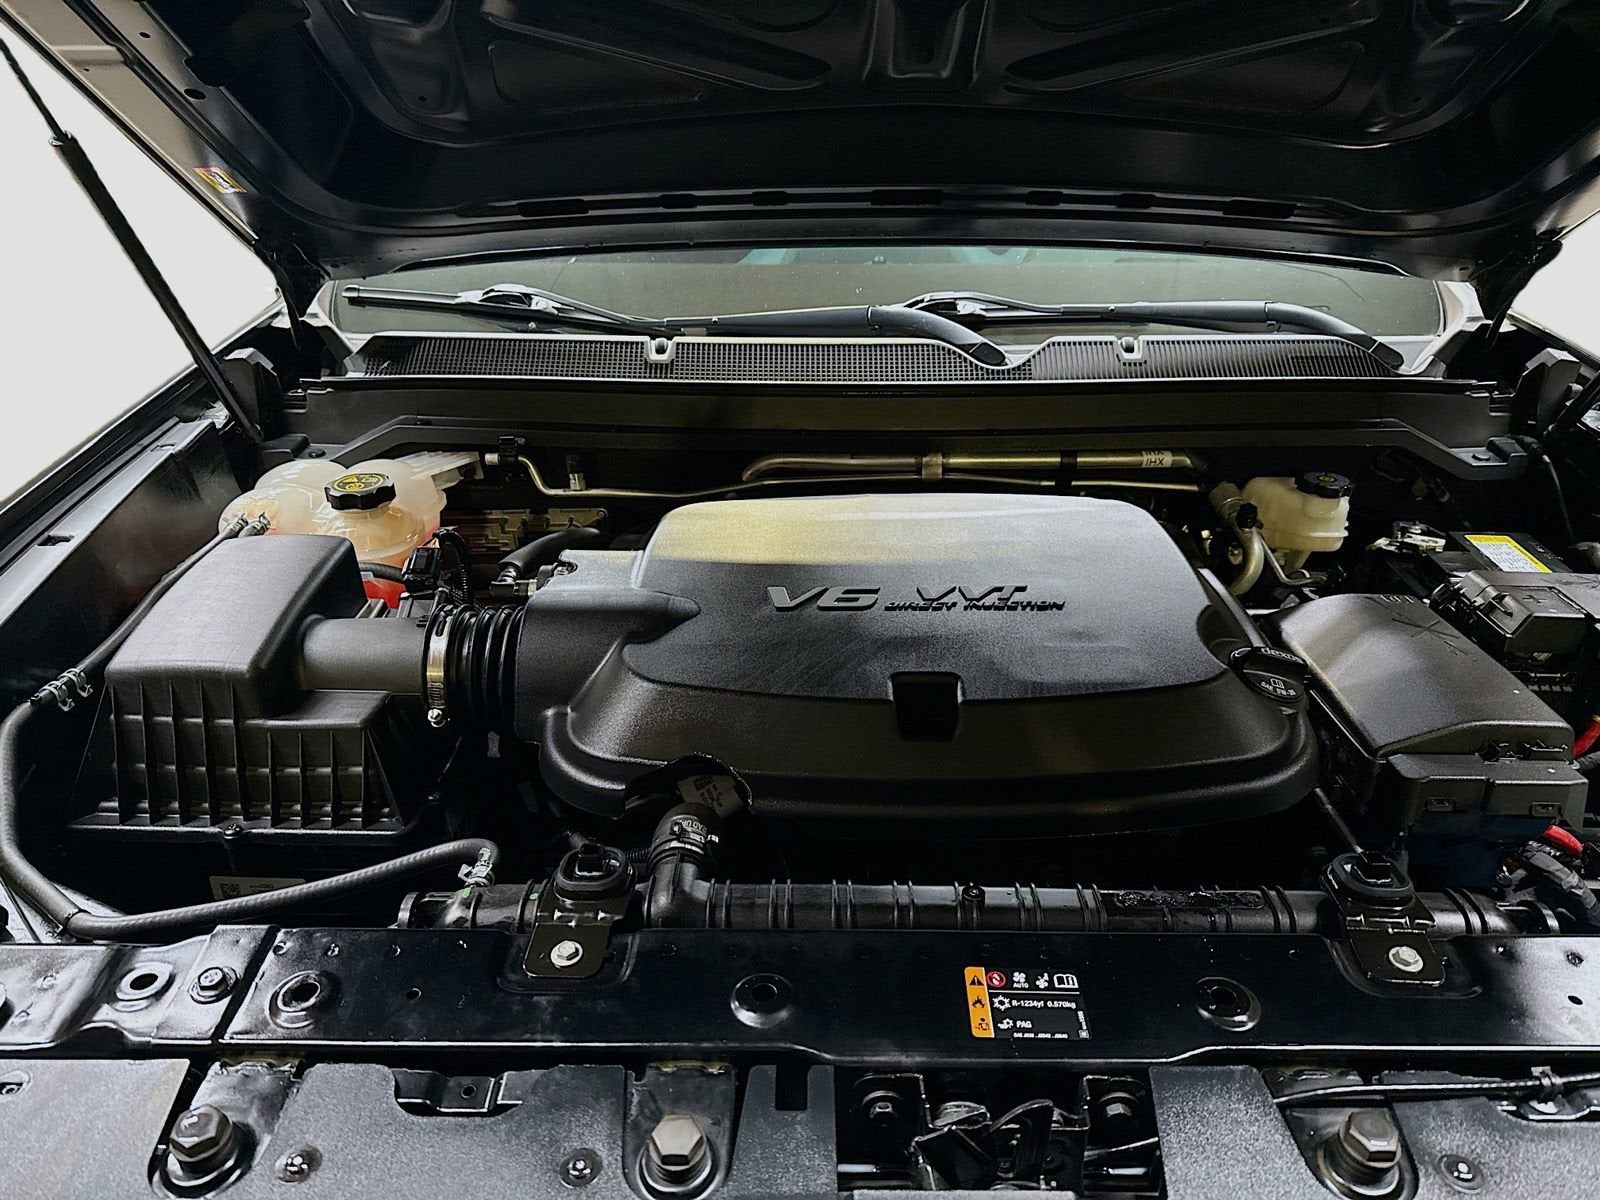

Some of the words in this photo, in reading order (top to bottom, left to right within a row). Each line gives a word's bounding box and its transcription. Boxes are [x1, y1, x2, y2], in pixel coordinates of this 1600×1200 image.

[766, 586, 880, 612] V6
[917, 585, 1028, 602] VVT
[884, 601, 957, 611] DIRECT
[964, 601, 1066, 611] INJECTION
[1016, 1020, 1033, 1029] PAG
